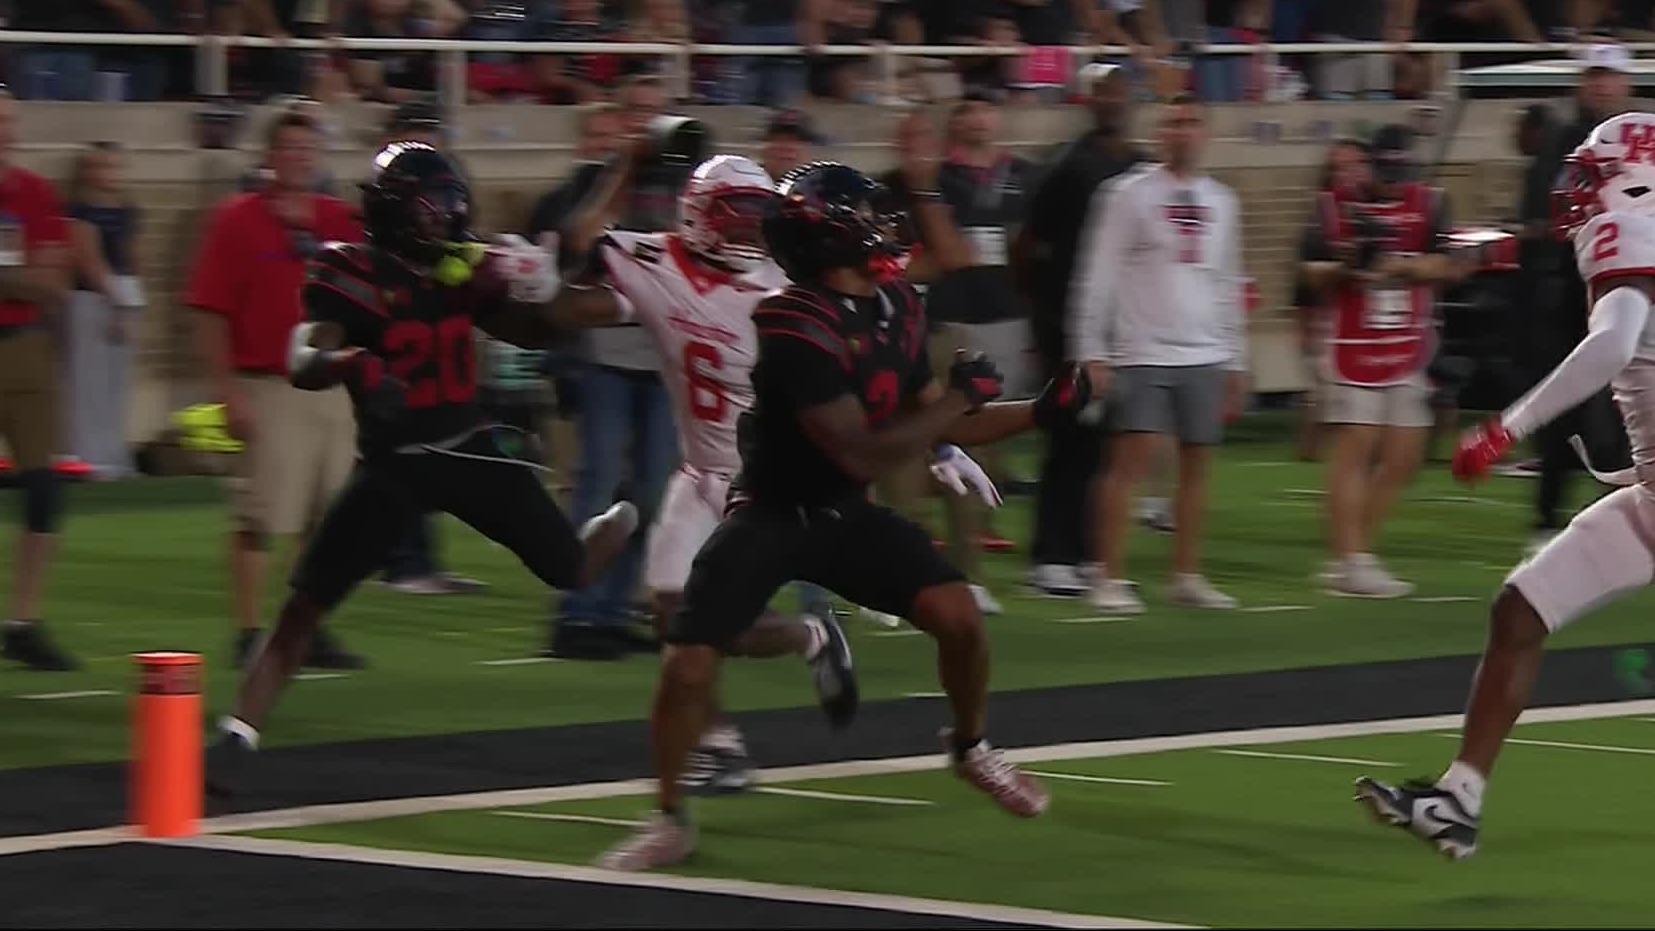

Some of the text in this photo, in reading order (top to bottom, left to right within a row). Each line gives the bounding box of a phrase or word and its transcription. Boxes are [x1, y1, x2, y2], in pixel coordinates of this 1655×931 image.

[1592, 222, 1619, 261] 2
[383, 315, 476, 410] 20
[685, 340, 728, 422] 6
